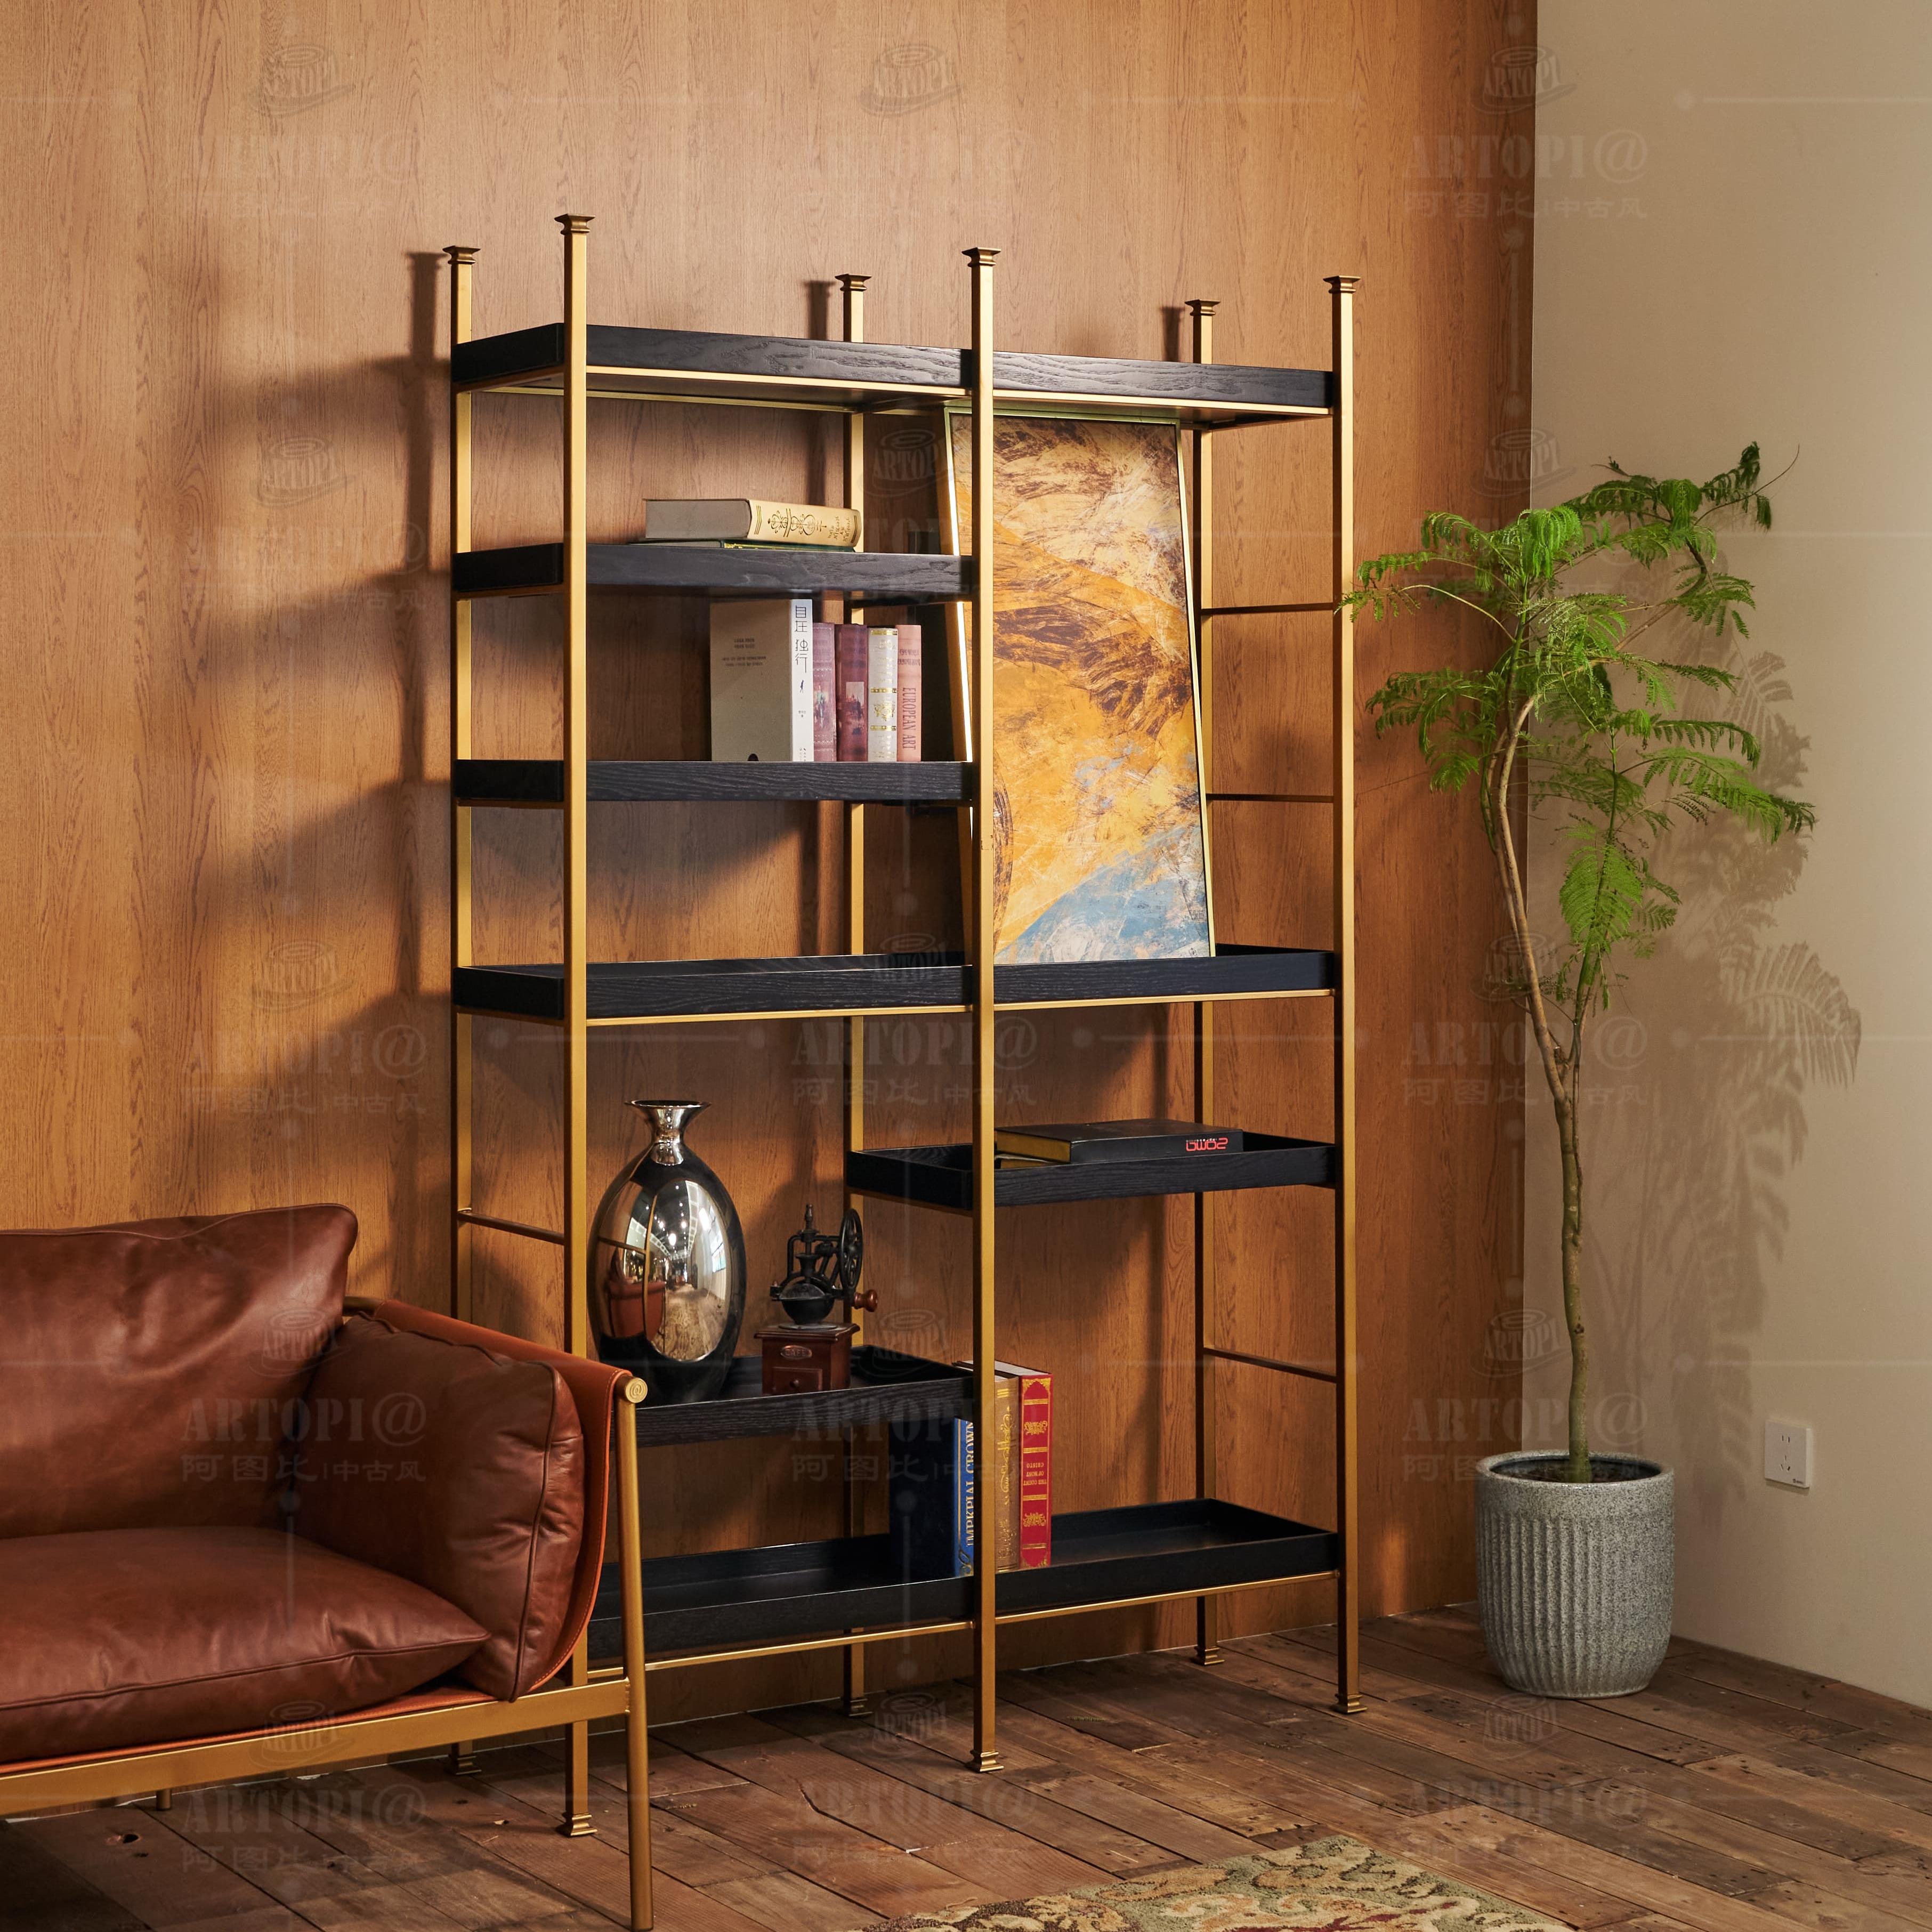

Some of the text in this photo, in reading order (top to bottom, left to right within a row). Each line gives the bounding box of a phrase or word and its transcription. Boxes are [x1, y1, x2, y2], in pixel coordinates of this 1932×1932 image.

[795, 605, 809, 673] 自在独行
[902, 687, 916, 750] EUROPEAN ART
